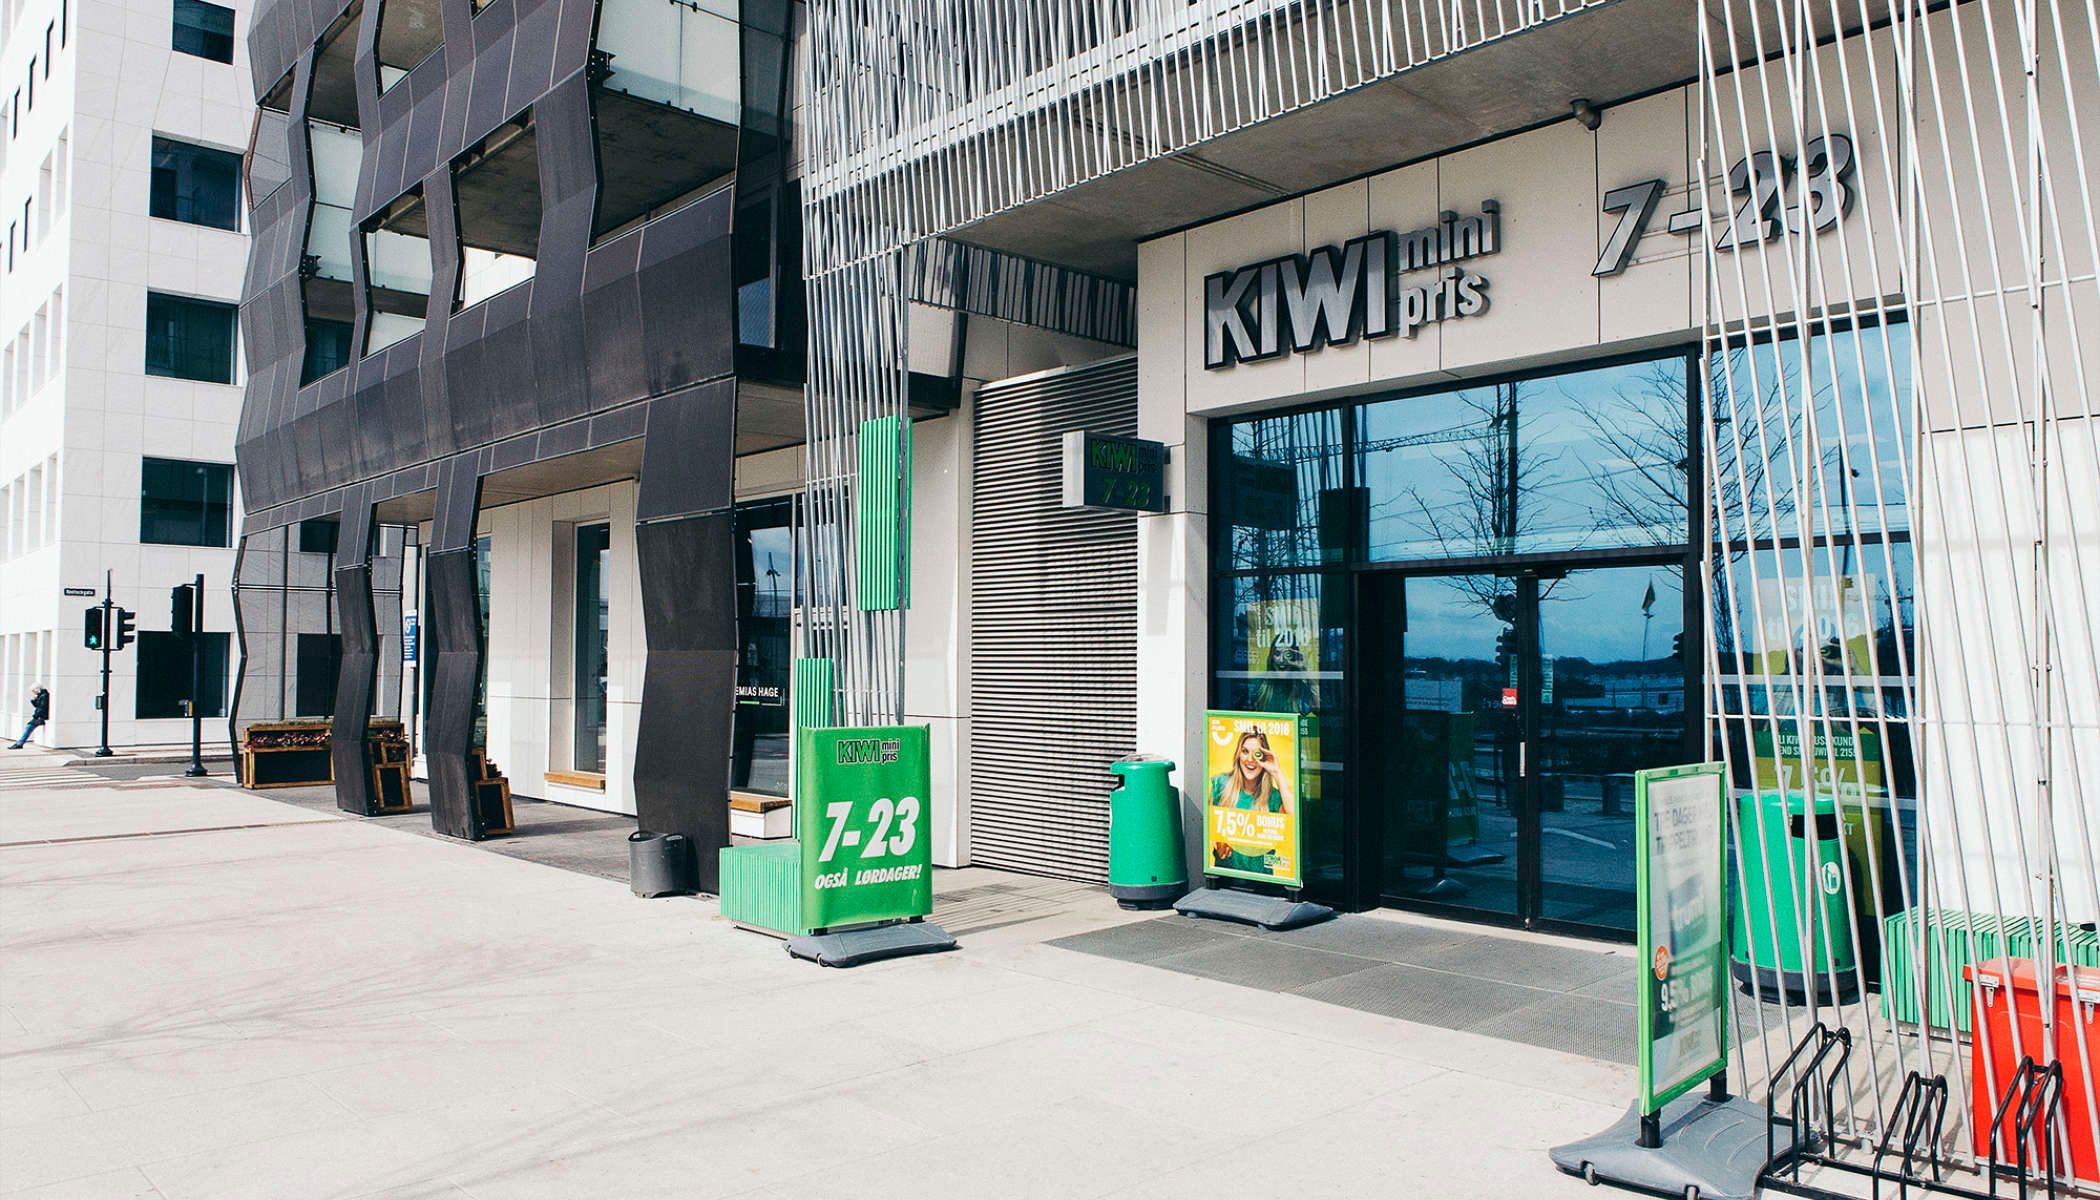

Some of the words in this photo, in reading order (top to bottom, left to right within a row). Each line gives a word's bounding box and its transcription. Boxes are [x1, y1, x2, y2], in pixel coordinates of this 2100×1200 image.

[1591, 133, 1855, 277] 7-23
[1204, 229, 1396, 370] KIWI
[1400, 199, 1500, 272] mini
[1400, 267, 1490, 339] pris
[1090, 439, 1138, 473] KIWI
[758, 687, 779, 698] HAGE
[1268, 722, 1290, 736] 2016
[837, 739, 881, 764] KIWI
[881, 738, 900, 751] mini
[881, 751, 898, 765] pris
[818, 796, 921, 863] 7-23
[1214, 809, 1255, 838] 7,5%
[815, 867, 849, 890] OGSÅ
[855, 864, 923, 886] LØRDAGER!
